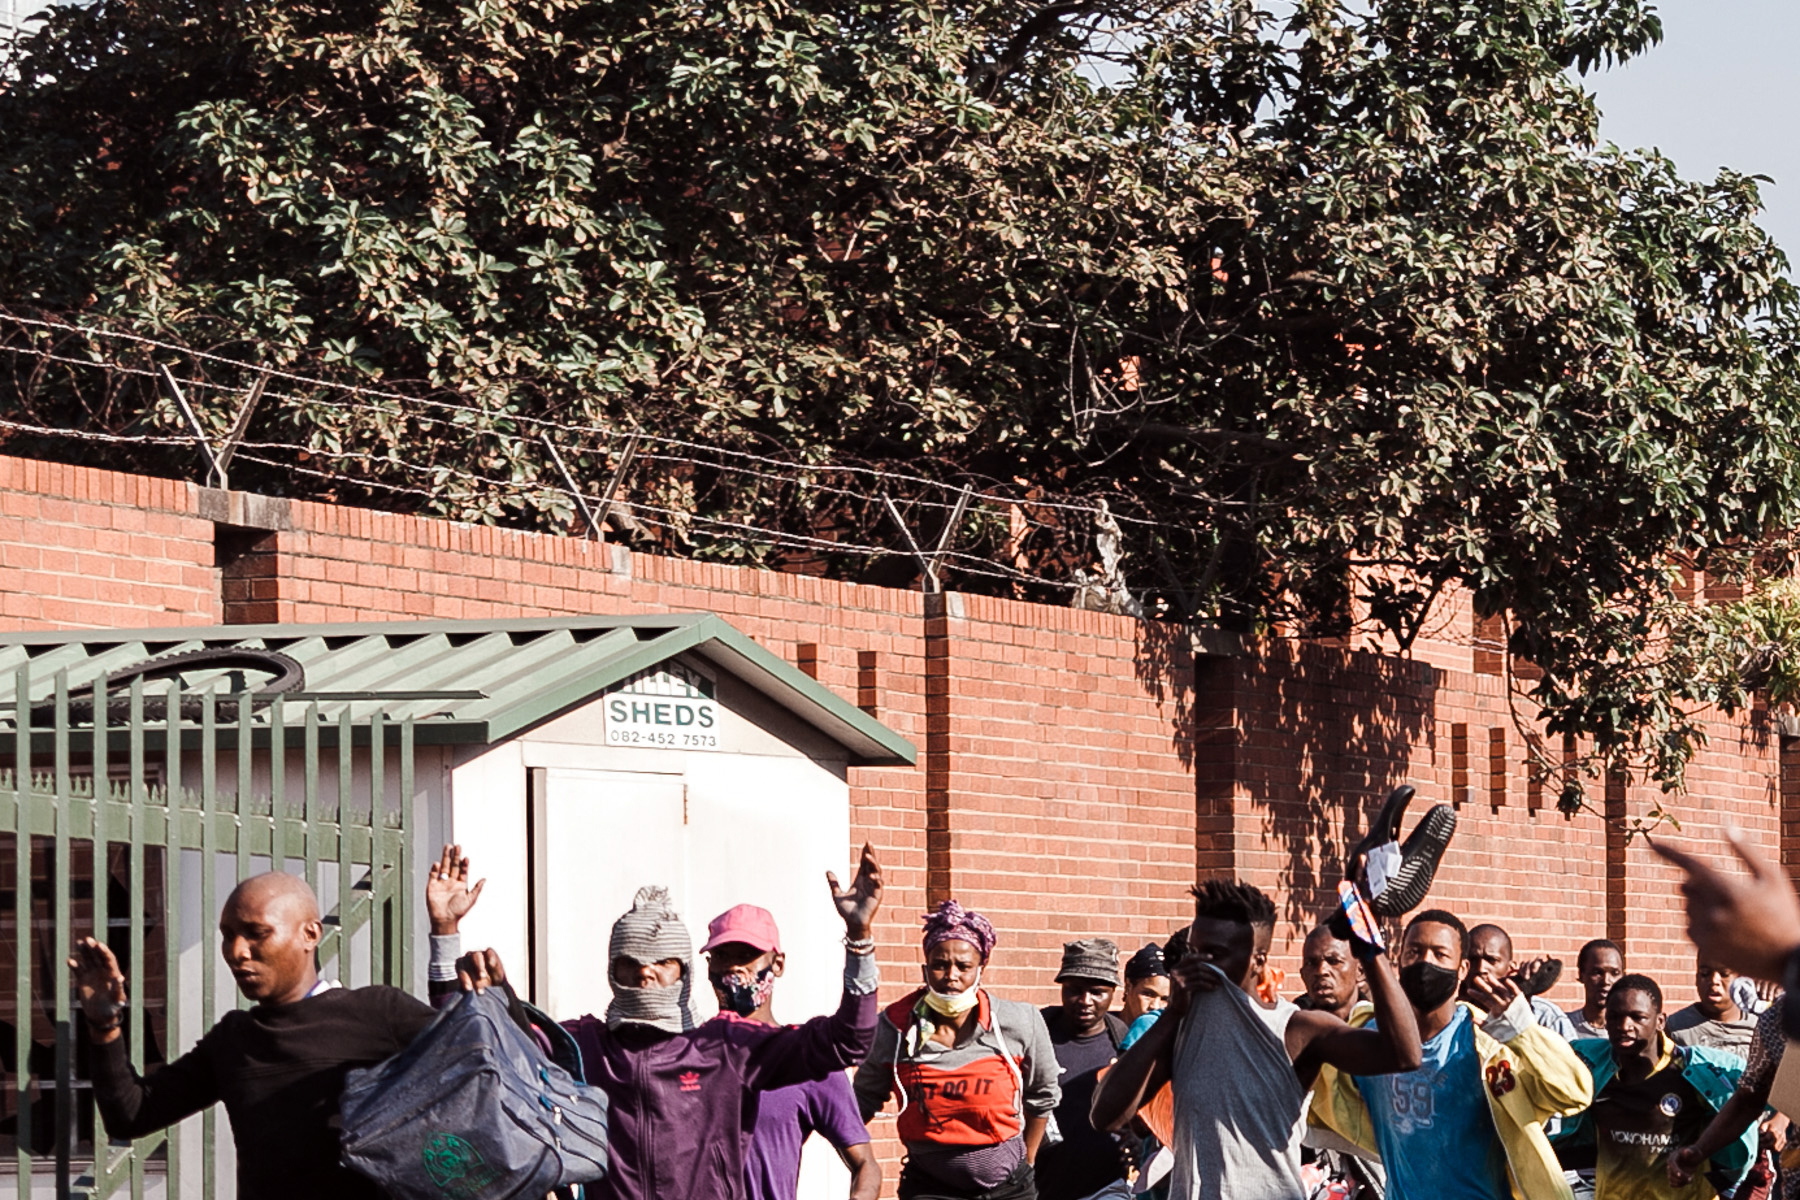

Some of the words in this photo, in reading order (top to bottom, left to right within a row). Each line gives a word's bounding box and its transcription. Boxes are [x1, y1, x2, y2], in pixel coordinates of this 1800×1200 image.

[610, 700, 714, 728] SHEDS
[610, 730, 676, 745] 082-452
[683, 734, 717, 747] 7573
[974, 1078, 994, 1095] IT
[1485, 1060, 1516, 1098] 23
[1391, 1073, 1434, 1120] 59
